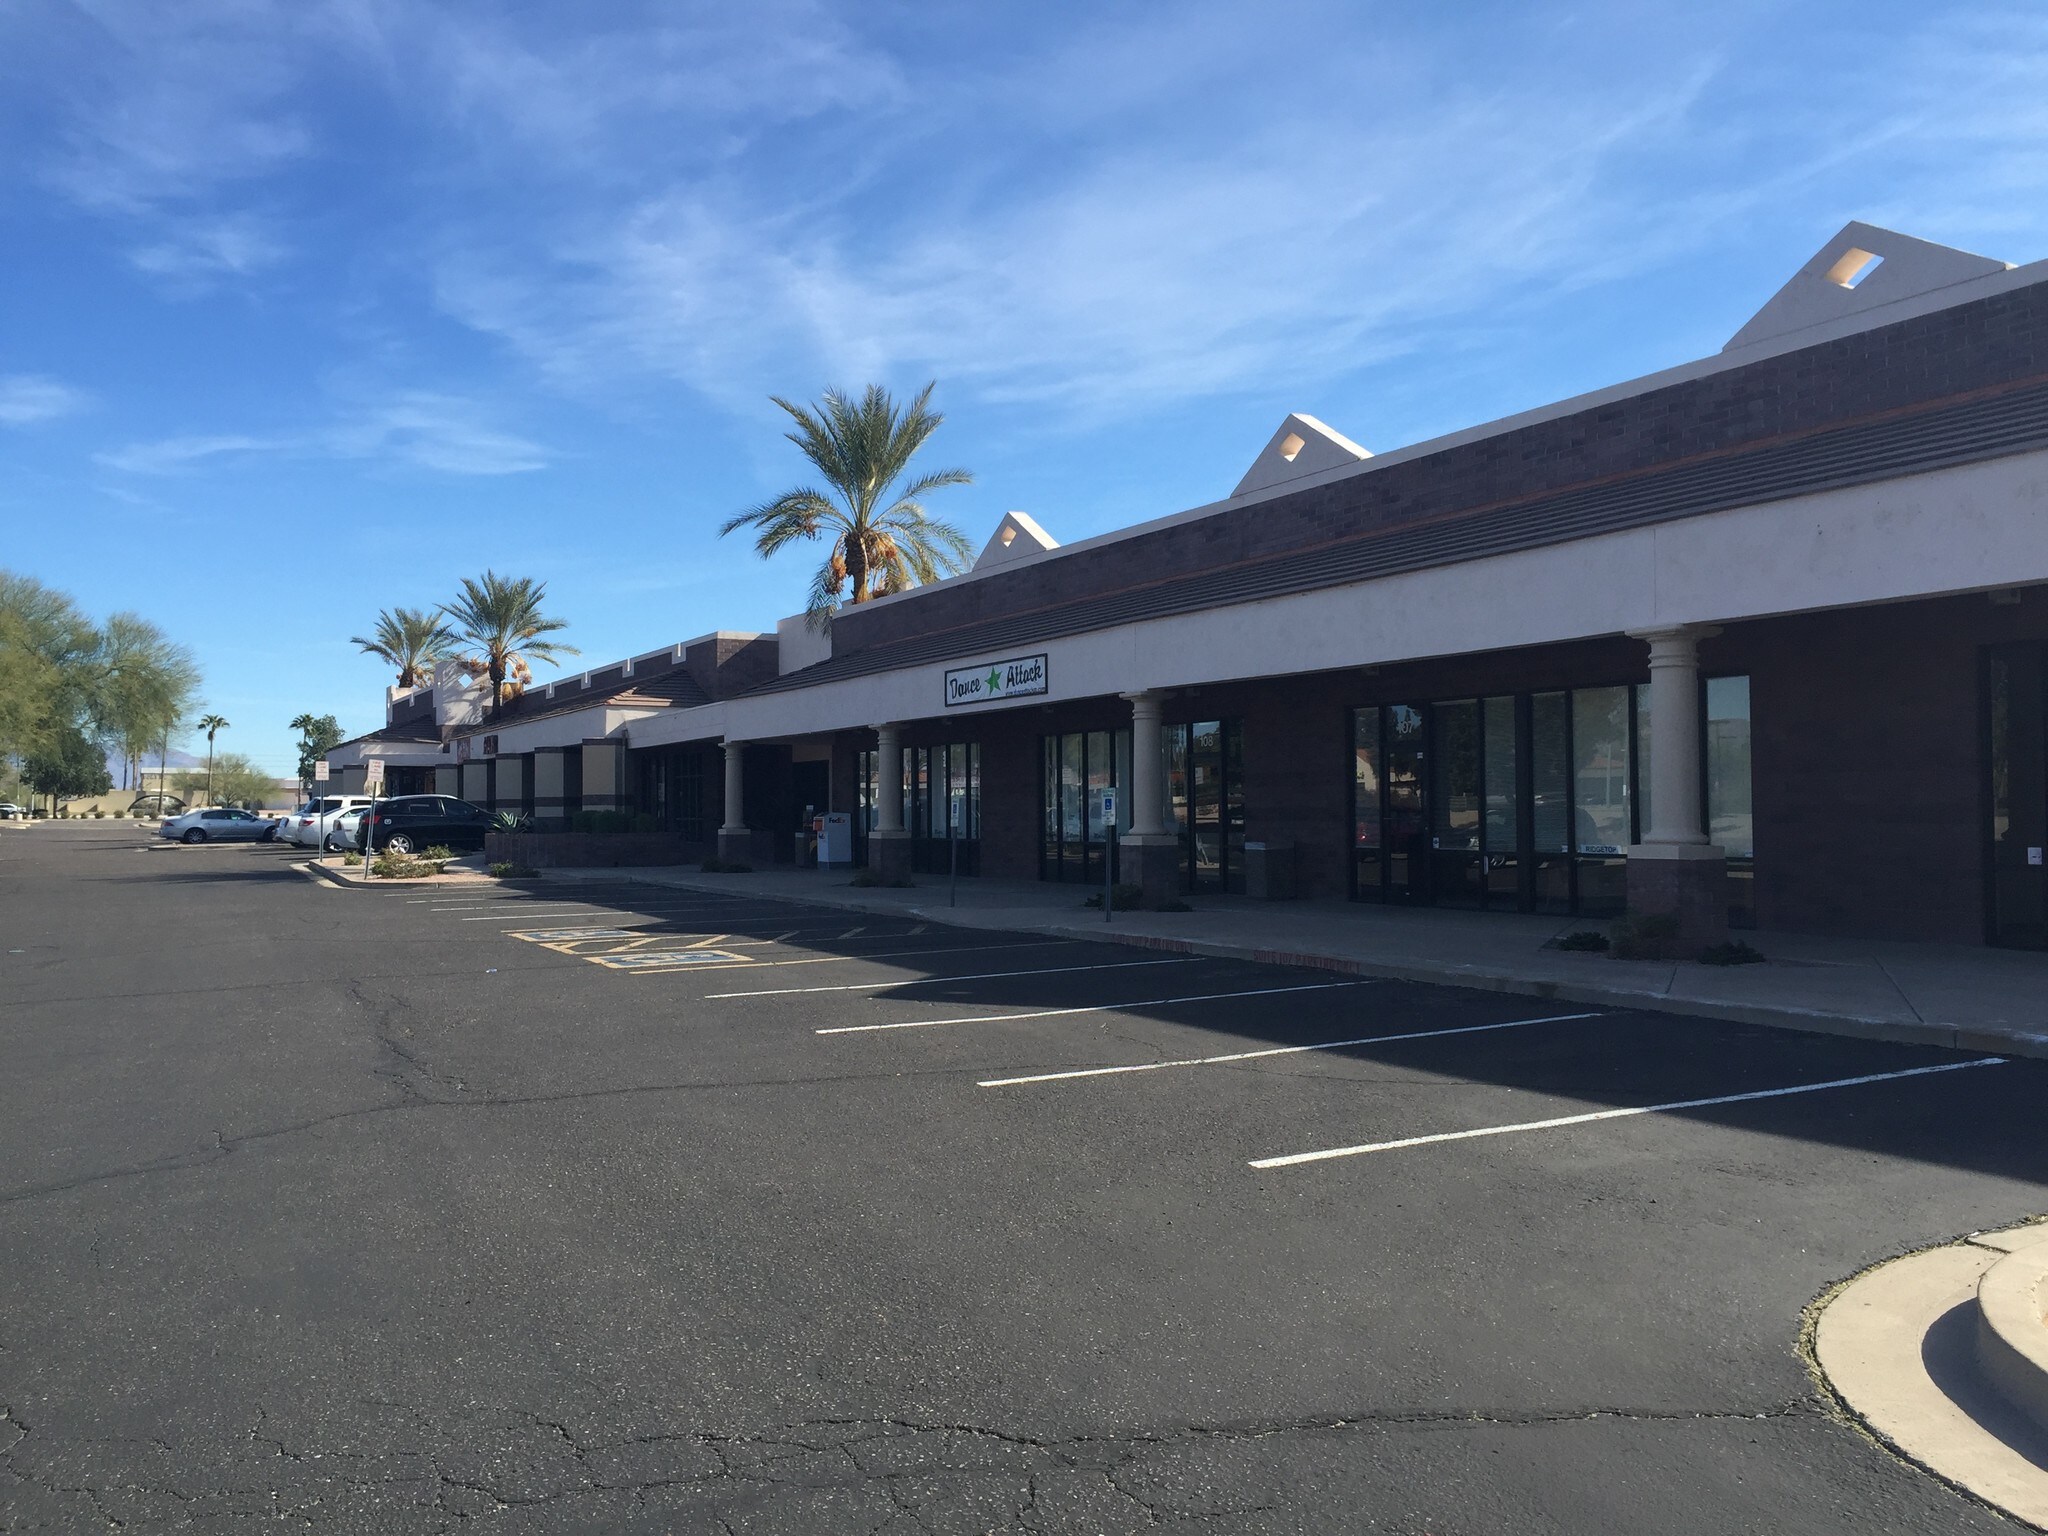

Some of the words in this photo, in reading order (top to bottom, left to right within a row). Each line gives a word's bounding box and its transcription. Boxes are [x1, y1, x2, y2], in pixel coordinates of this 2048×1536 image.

[949, 678, 982, 699] Dance
[1005, 659, 1043, 688] Attack
[1200, 735, 1214, 747] 108
